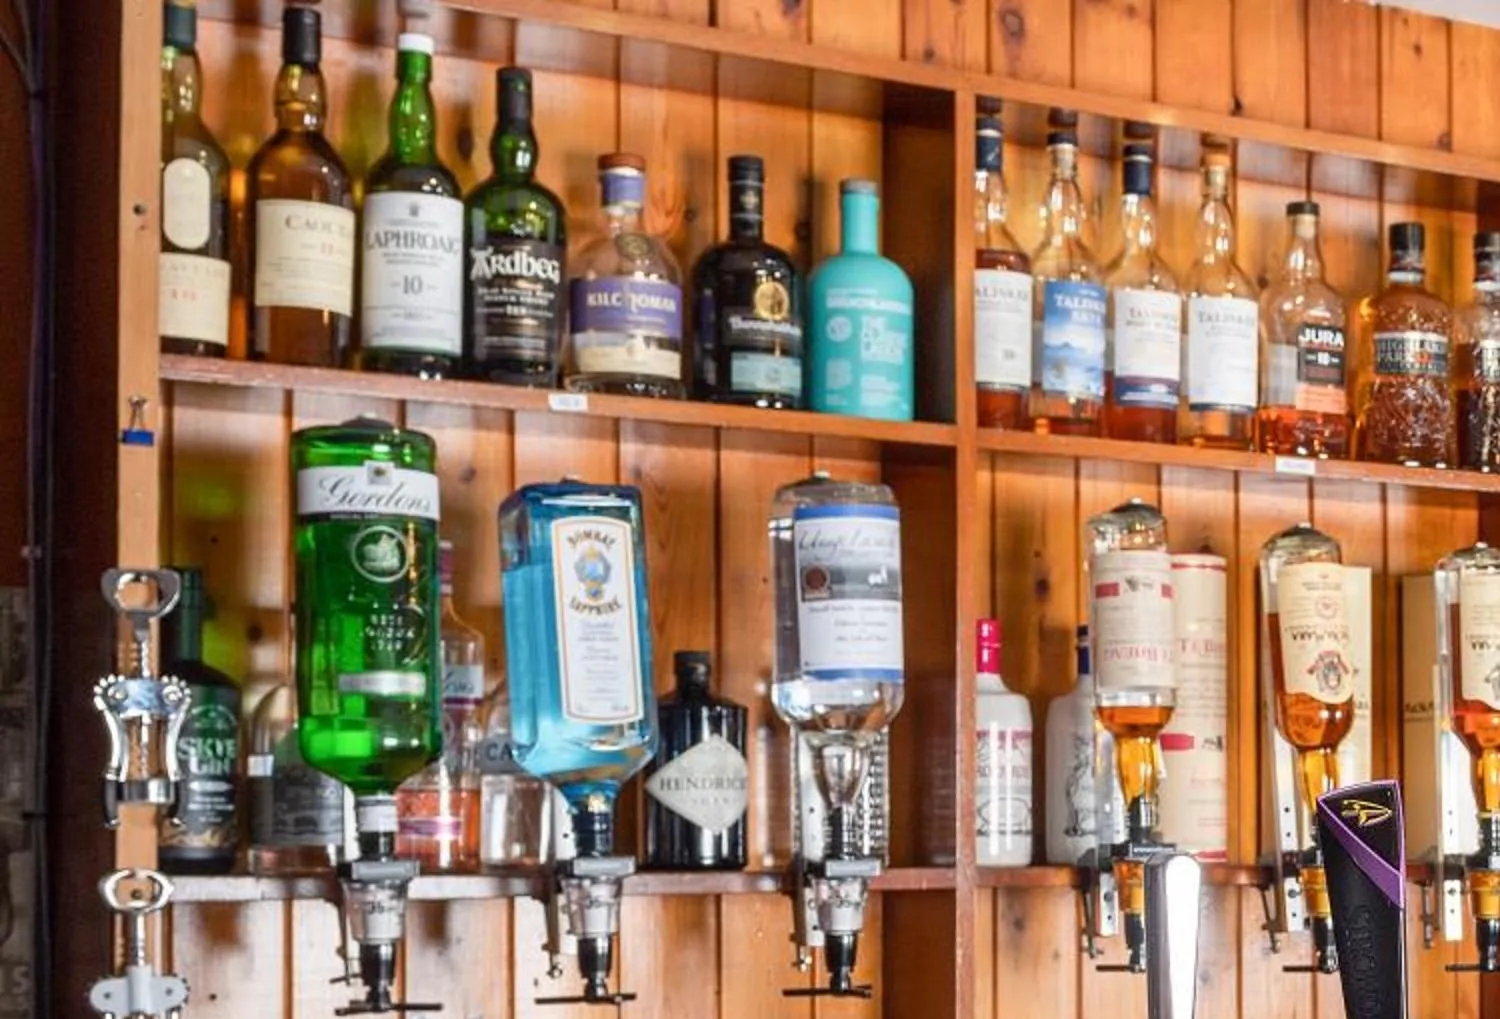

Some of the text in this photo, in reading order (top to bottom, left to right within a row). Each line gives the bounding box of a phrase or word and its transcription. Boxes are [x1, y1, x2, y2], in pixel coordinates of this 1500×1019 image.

[403, 275, 423, 294] 10
[1299, 328, 1345, 347] JURA
[178, 738, 236, 758] SKYE
